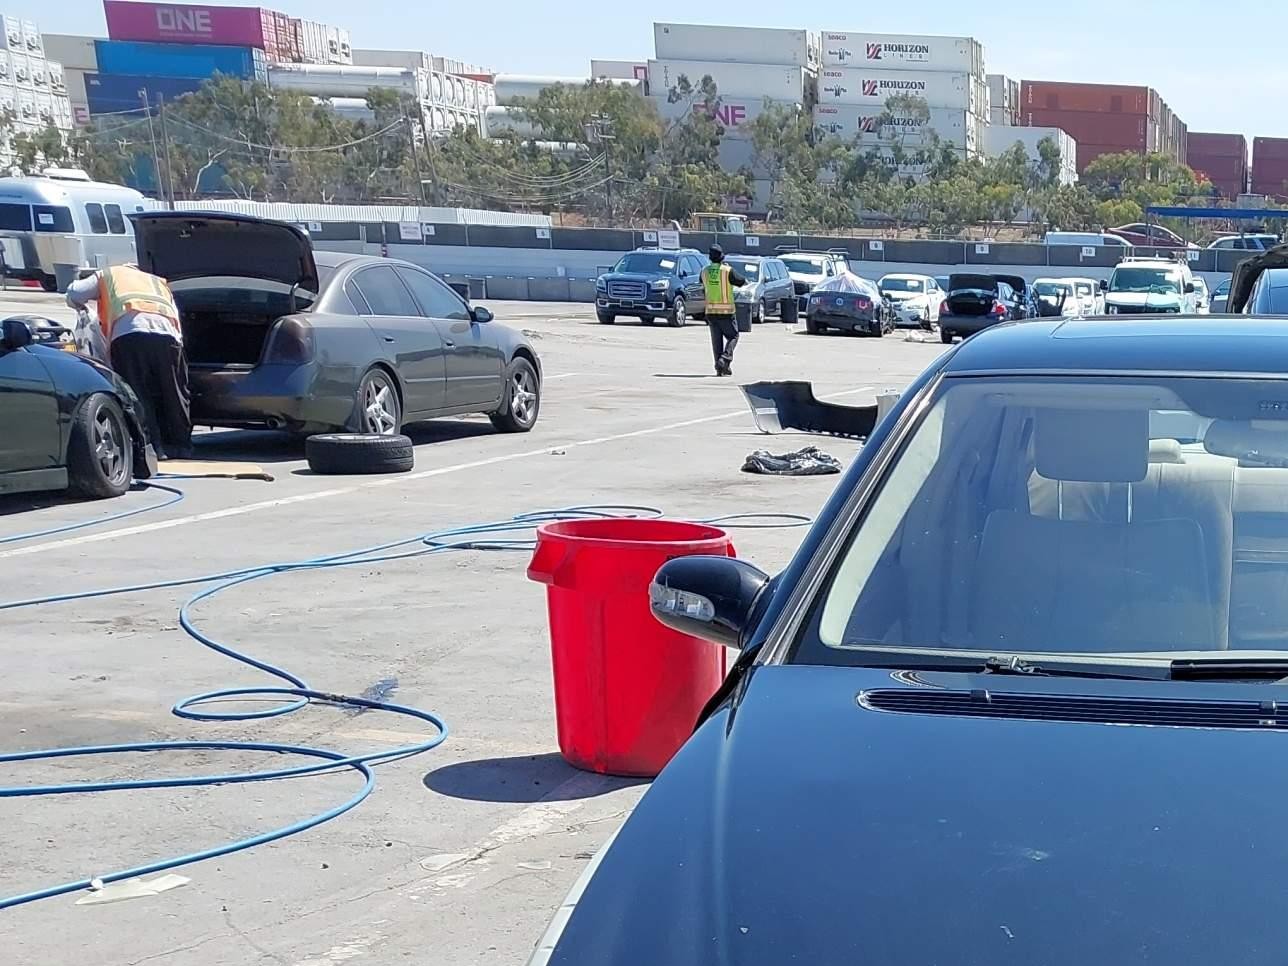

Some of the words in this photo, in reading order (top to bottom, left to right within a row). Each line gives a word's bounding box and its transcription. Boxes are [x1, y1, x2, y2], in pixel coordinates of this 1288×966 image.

[155, 7, 213, 32] ONE
[883, 43, 929, 53] HORIZON
[879, 80, 925, 90] HORIZON
